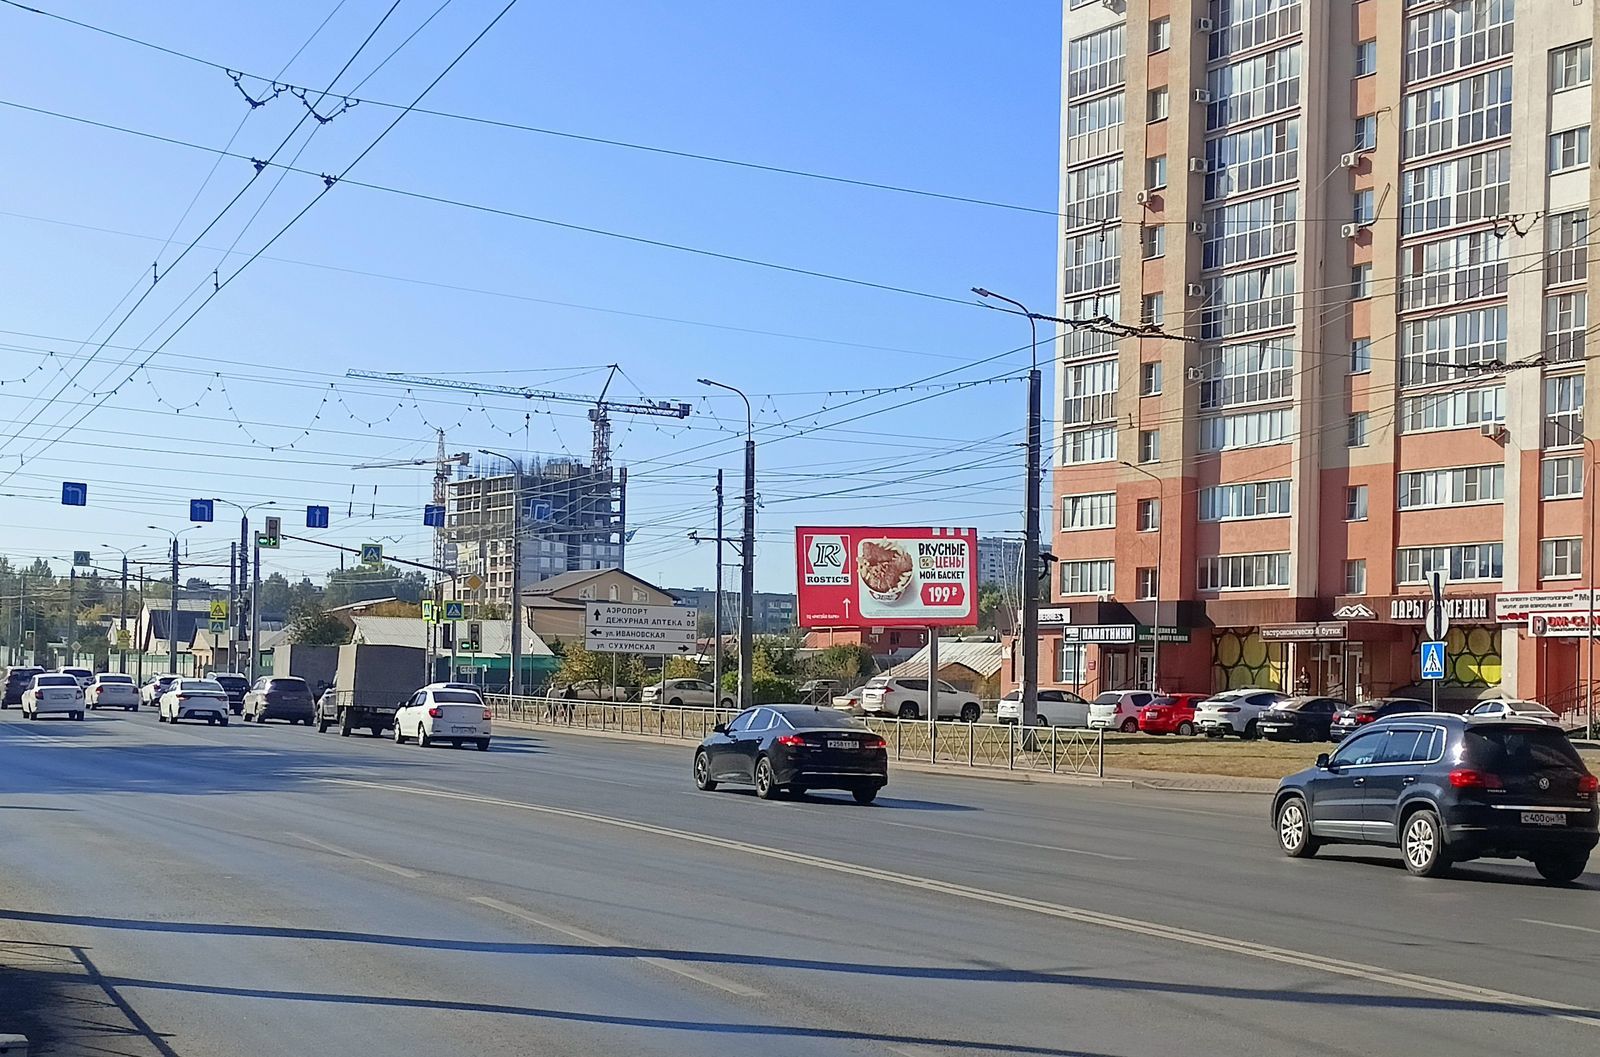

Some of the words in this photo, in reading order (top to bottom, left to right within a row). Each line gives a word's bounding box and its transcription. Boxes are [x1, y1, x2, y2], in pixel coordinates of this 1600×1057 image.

[918, 542, 966, 556] ВКУСНЫЕ
[934, 556, 965, 569] ЦЕНЫ
[806, 575, 849, 584] ROSTIC'S
[919, 568, 936, 580] МОЙ
[937, 570, 965, 580] БАСКЕТ
[606, 607, 648, 615] АЭРОПОРТ
[686, 610, 696, 618] 23
[1390, 599, 1424, 619] ДАРЫ
[605, 617, 649, 625] ДЕЖУРНАЯ
[651, 618, 682, 626] АПТЕКА
[615, 629, 666, 639] ИВАНОВСКАЯ
[1082, 627, 1132, 640] ПАМЯТНИКИ
[608, 642, 656, 651] СУХУМСКАЯ
